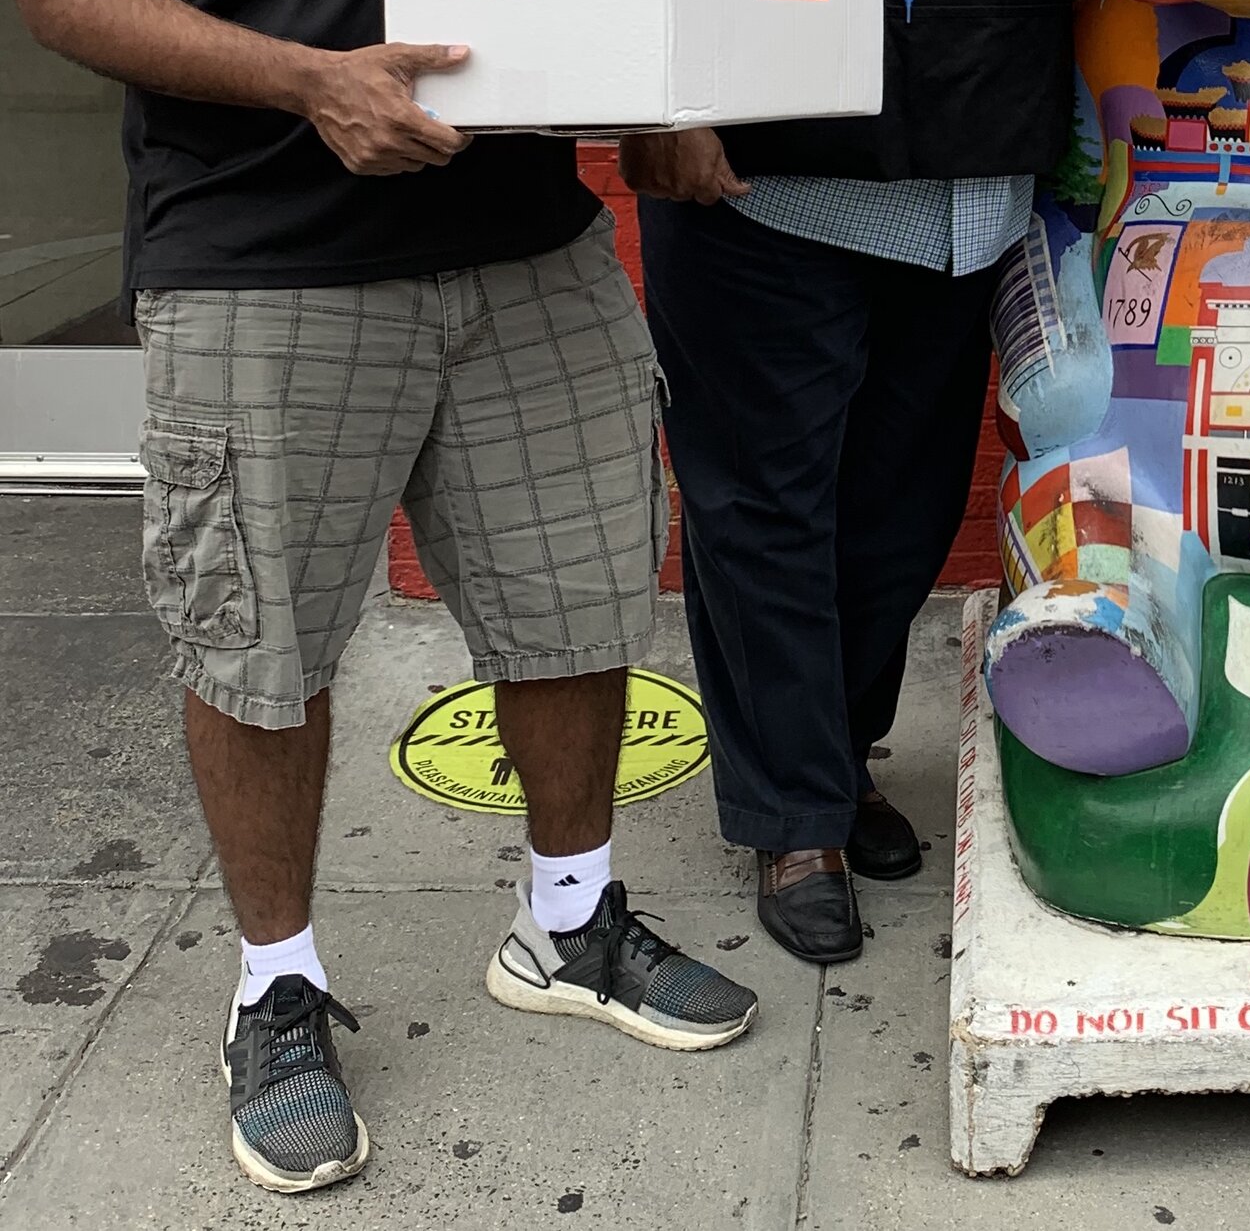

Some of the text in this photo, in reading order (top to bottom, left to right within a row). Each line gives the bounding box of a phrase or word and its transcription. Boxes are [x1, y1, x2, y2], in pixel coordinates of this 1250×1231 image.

[1107, 297, 1152, 329] 1789
[1222, 475, 1246, 487] 1213
[626, 710, 681, 730] ERE
[411, 759, 448, 790] PLEASE
[451, 783, 527, 805] MAINTAIN
[1009, 1008, 1058, 1036] DO
[1166, 1004, 1225, 1031] SIT
